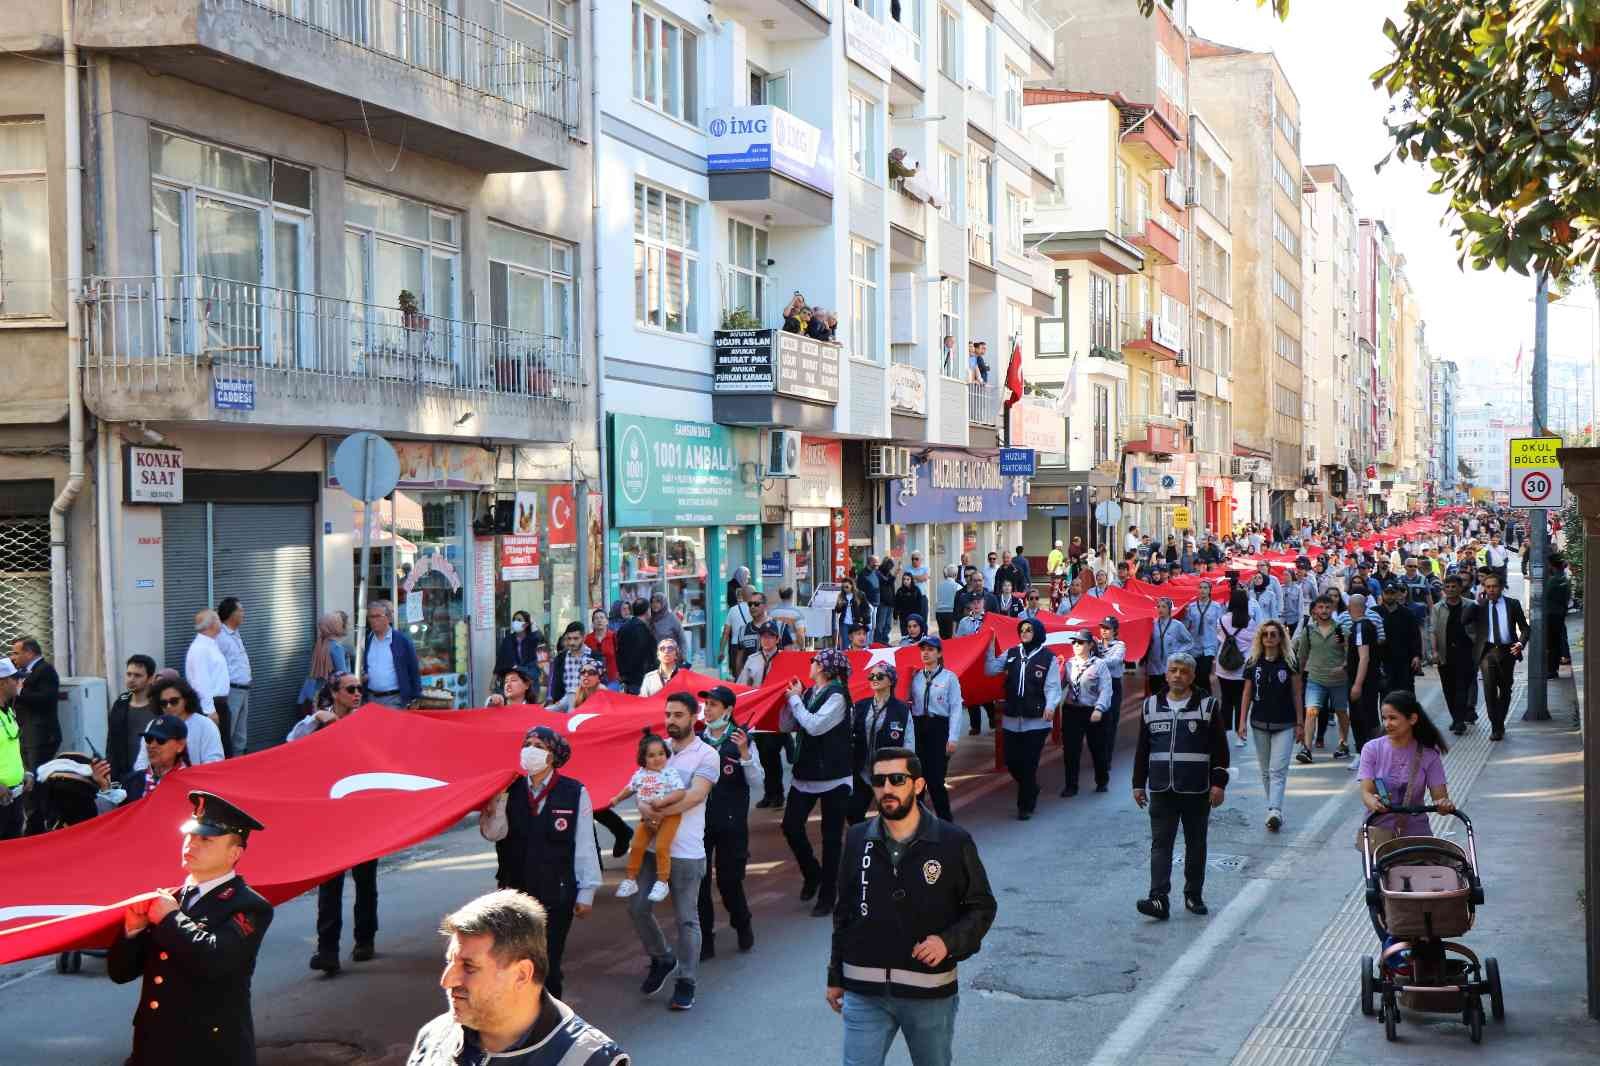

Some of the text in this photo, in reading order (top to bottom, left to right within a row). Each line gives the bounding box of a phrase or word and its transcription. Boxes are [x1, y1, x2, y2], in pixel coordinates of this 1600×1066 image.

[730, 116, 768, 134] İMG
[743, 337, 770, 346] ASLAN
[719, 355, 768, 364] MURAT PAK
[716, 373, 742, 381] FURKAN
[654, 441, 683, 468] 1001
[1521, 444, 1552, 452] OKUL
[136, 452, 182, 469] KONAK
[1004, 452, 1027, 461] HUZUR
[1514, 454, 1556, 464] BÖLGES
[141, 470, 176, 486] SAAT
[933, 459, 961, 489] HUZUR
[1527, 480, 1546, 493] 30
[860, 841, 874, 916] POLİS
